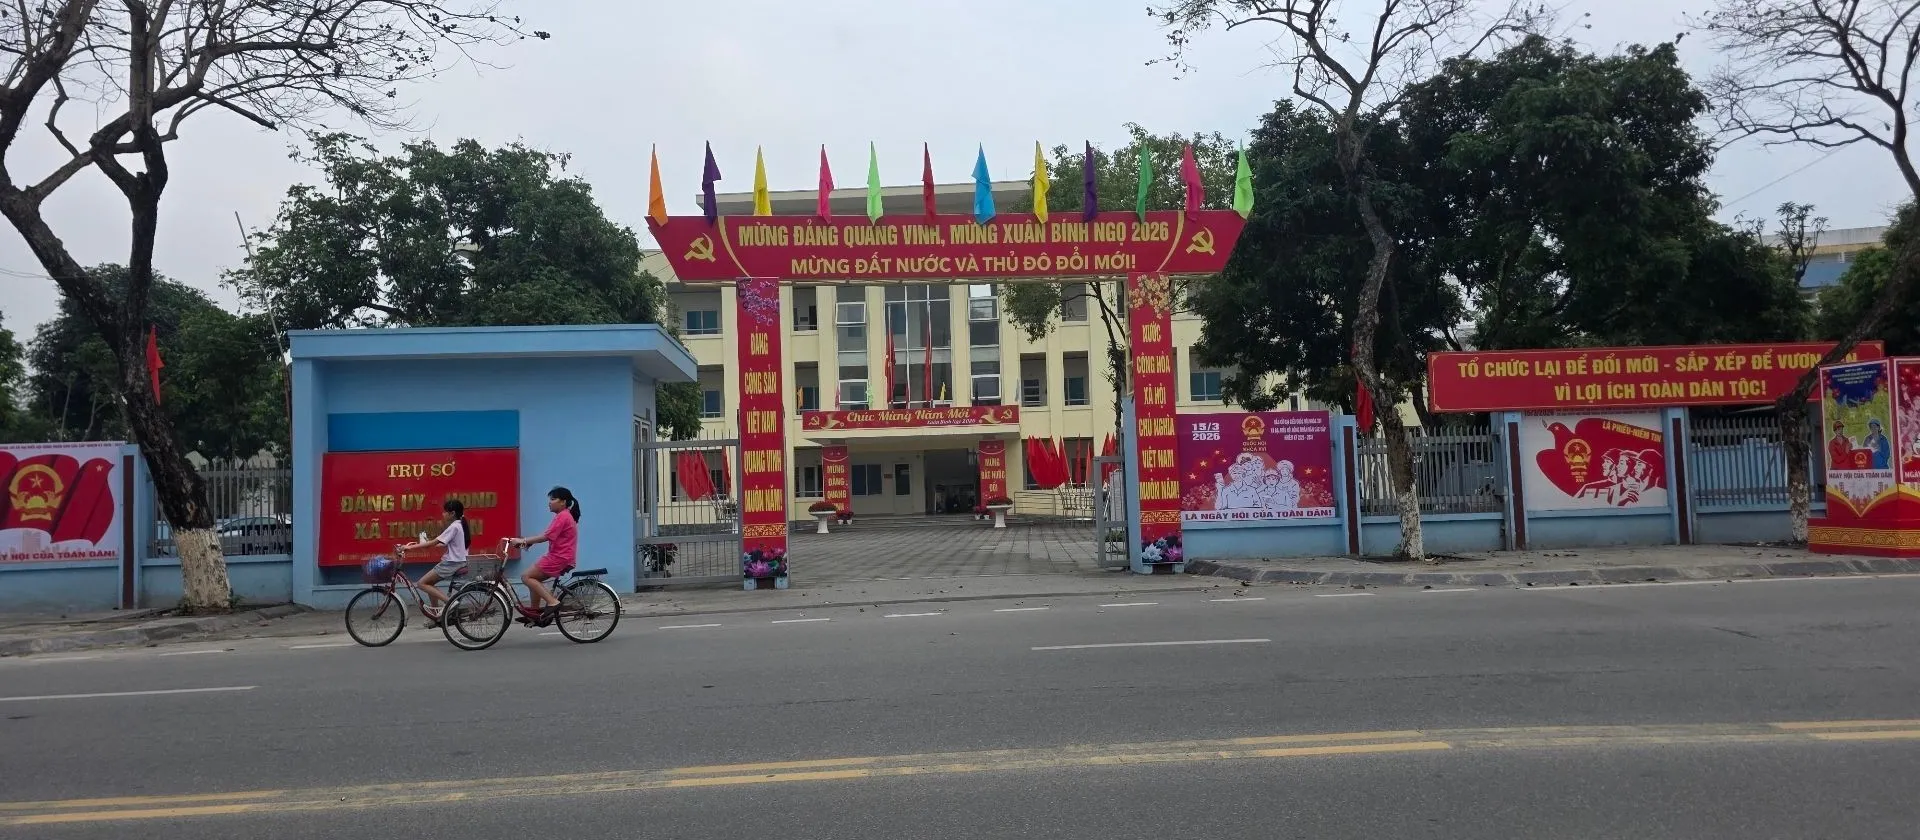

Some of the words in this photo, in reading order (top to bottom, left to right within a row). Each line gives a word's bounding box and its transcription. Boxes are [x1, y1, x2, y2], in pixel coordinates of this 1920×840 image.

[739, 221, 788, 246] MỪNG
[793, 219, 838, 246] ĐẢNG
[844, 225, 897, 248] QUANG
[903, 225, 945, 247] VINH,
[950, 220, 997, 245] MỪNG
[1003, 219, 1046, 244] XUÂN
[1052, 218, 1088, 243] BÍNH
[1094, 222, 1126, 246] NGỌ
[1131, 222, 1169, 242] 2026
[791, 254, 850, 274] MỪNG
[855, 252, 891, 274] ĐẤT
[896, 253, 951, 273] NƯỚC
[955, 253, 979, 272] VÀ
[983, 250, 1018, 272] THỦ
[1023, 252, 1051, 271] ĐÔ
[1056, 246, 1089, 271] ĐỔI
[1094, 251, 1136, 270] MỚI!
[750, 325, 769, 355] ĐẢNG
[1142, 321, 1161, 343] NƯỚC
[1136, 352, 1155, 378] CỘNG
[1458, 356, 1479, 378] TỔ
[1484, 358, 1529, 377] CHỨC
[1535, 360, 1560, 379] LẠI
[1566, 353, 1588, 375] ĐỂ
[1592, 352, 1621, 374] ĐỔI
[1626, 355, 1658, 373] MỚI
[1675, 351, 1708, 372] SẮP
[1714, 350, 1746, 371] XẾP
[1751, 349, 1773, 370] ĐỂ
[744, 367, 762, 400] CỘNG
[763, 363, 777, 394] SẢN
[1554, 382, 1571, 401] VÌ
[1576, 384, 1602, 403] LỢI
[1607, 381, 1635, 399] ÍCH
[1640, 379, 1684, 398] TOÀN
[1689, 378, 1724, 397] DÂN
[1728, 377, 1767, 399] TỘC!
[1143, 383, 1154, 405] XÃ
[1154, 382, 1167, 408] HỘI
[746, 406, 760, 438] VIỆT
[761, 410, 777, 433] NAM
[847, 411, 874, 422] Chúc
[879, 410, 911, 423] Mừng
[915, 410, 944, 420] Năm
[947, 408, 970, 419] Mới
[1138, 412, 1153, 436] CHỦ
[1153, 413, 1175, 436] NGHĨA
[1192, 422, 1220, 431] 15/3
[1192, 432, 1220, 441] 2026
[387, 463, 425, 481] TRỤ
[430, 458, 456, 477] SỞ
[744, 450, 765, 476] QUANG
[766, 450, 782, 472] VINH
[1142, 445, 1156, 472] VIỆT
[1157, 449, 1174, 468] NAM
[341, 488, 395, 513] ĐẢNG
[401, 488, 425, 512] ỦY
[744, 484, 764, 512] MUÔN
[765, 484, 783, 511] NĂM!
[827, 490, 847, 499] QUANG
[1139, 477, 1160, 500] MUÔN
[1185, 511, 1197, 521] LÀ
[1201, 511, 1229, 520] NGÀY
[1232, 511, 1249, 519] HỘI
[1252, 510, 1274, 519] CỦA
[1276, 509, 1304, 518] TOÀN
[1306, 509, 1332, 517] DÂN!
[354, 517, 381, 540] XÃ
[11, 552, 30, 562] HỘI
[33, 551, 54, 560] CỦA
[57, 550, 85, 559] TOÀN
[89, 550, 115, 558] DÂN!
